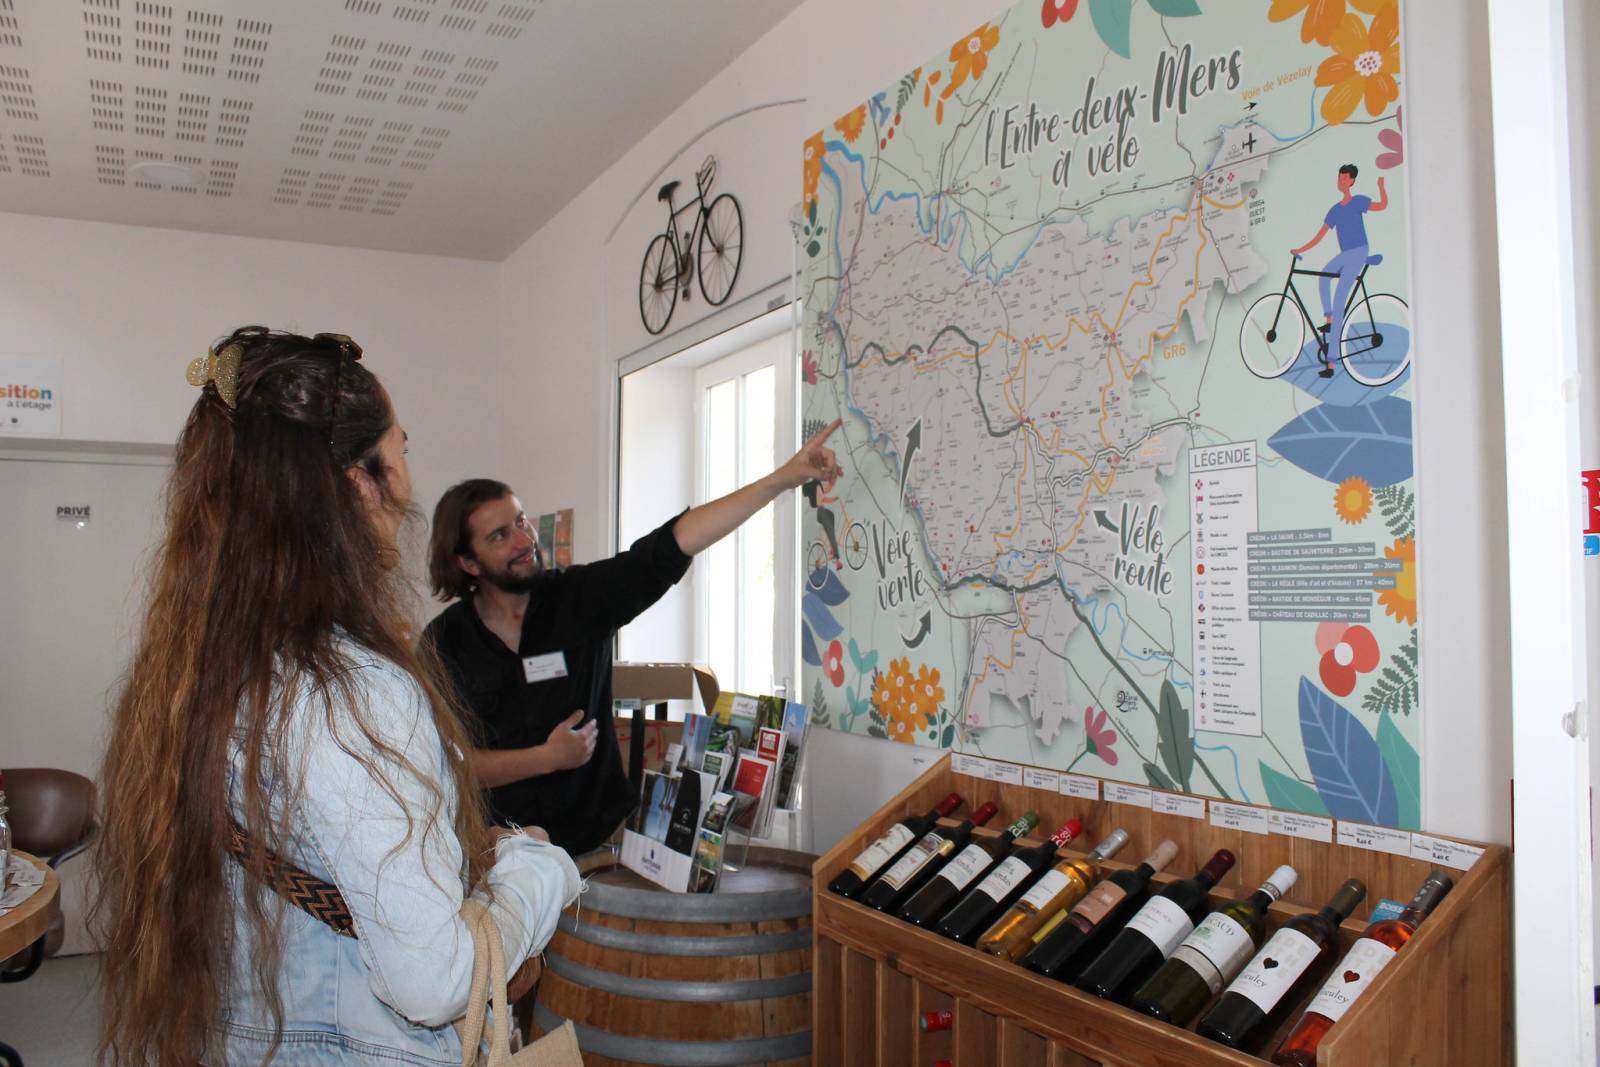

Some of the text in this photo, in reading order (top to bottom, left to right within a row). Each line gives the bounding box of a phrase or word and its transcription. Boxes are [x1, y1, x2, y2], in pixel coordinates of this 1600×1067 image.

[1240, 64, 1313, 101] Voie de Vézelay
[1052, 111, 1141, 188] à vélo
[1162, 343, 1186, 360] GR6
[0, 384, 52, 400] sition
[16, 400, 52, 411] l'étage
[1193, 446, 1252, 469] LÉGENDE
[56, 505, 91, 517] PRIVÉ
[1119, 501, 1164, 556] Vélo
[872, 519, 912, 580] Voie
[878, 551, 927, 611] verte
[1113, 552, 1173, 596] route
